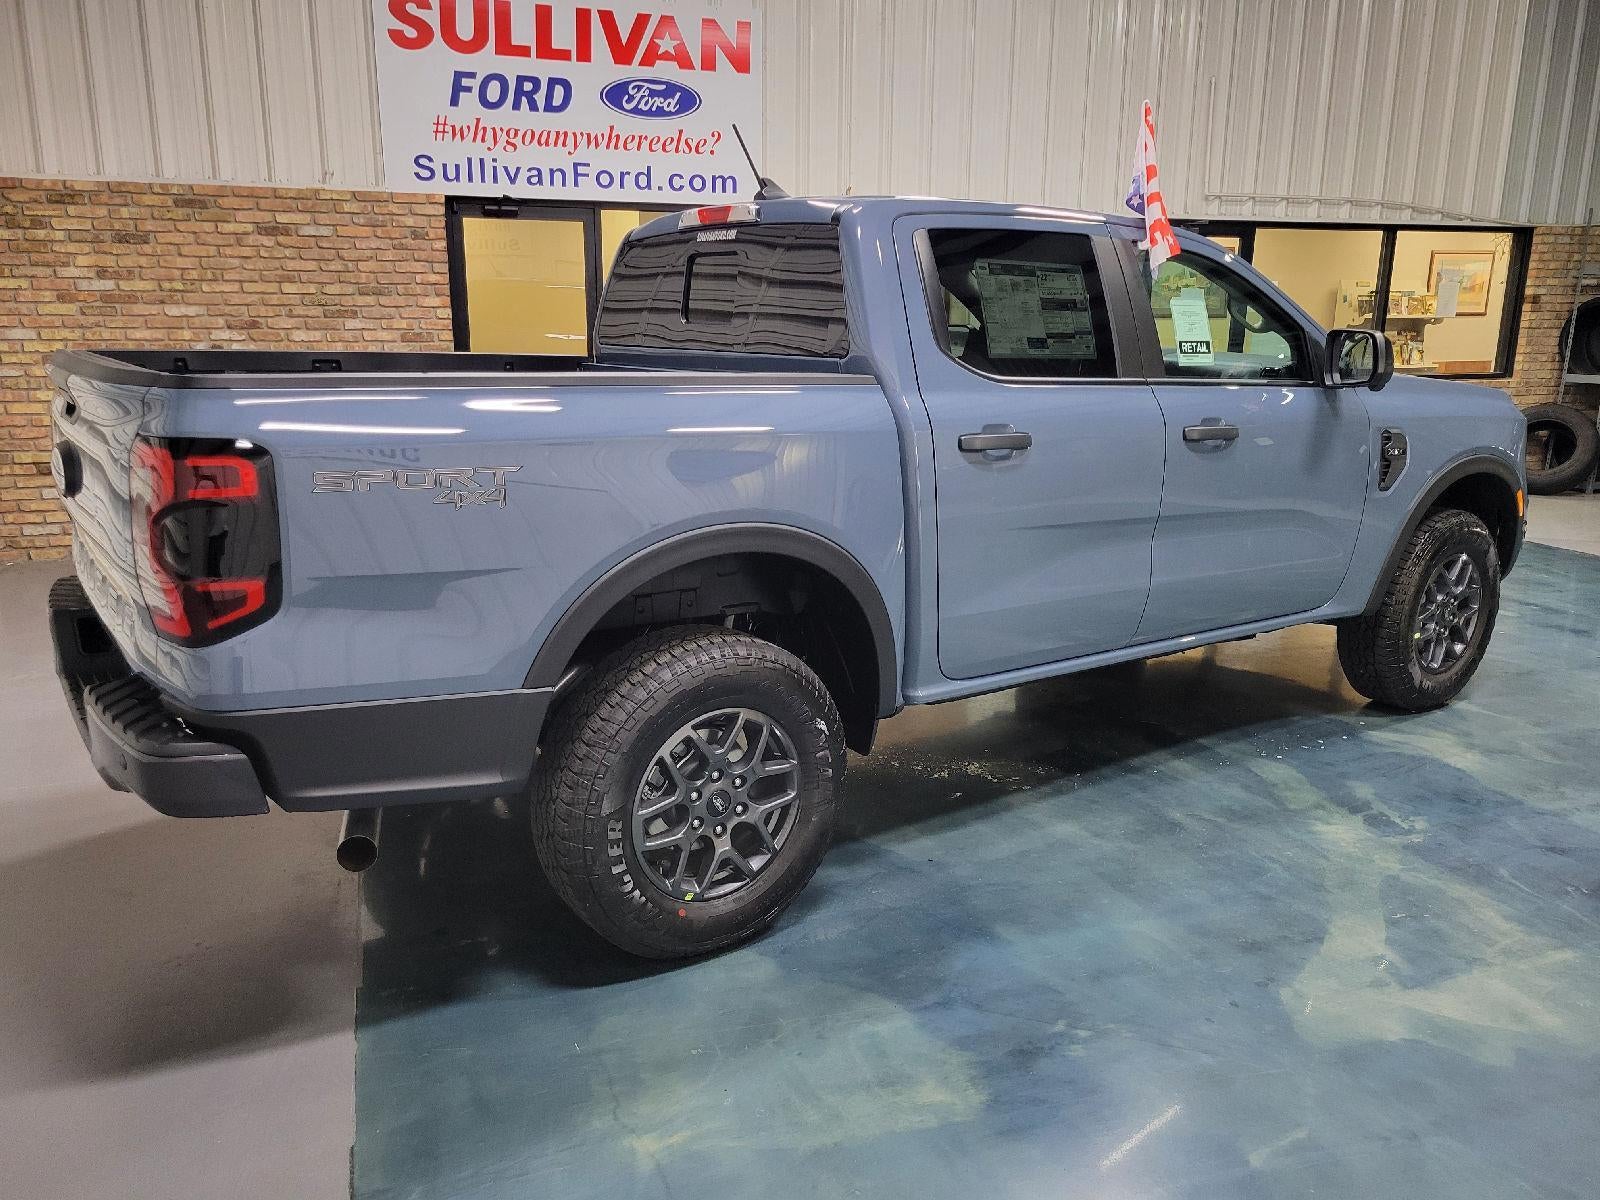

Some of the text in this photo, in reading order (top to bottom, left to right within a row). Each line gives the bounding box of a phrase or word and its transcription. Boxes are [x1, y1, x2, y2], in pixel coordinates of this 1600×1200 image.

[387, 0, 751, 74] SULLIVAN
[449, 70, 682, 113] FORD Ford
[432, 114, 722, 156] #whygoanywhereelse?
[413, 154, 738, 194] SullivanFord.com
[1181, 342, 1209, 353] RETAIL
[312, 465, 523, 493] SPORT
